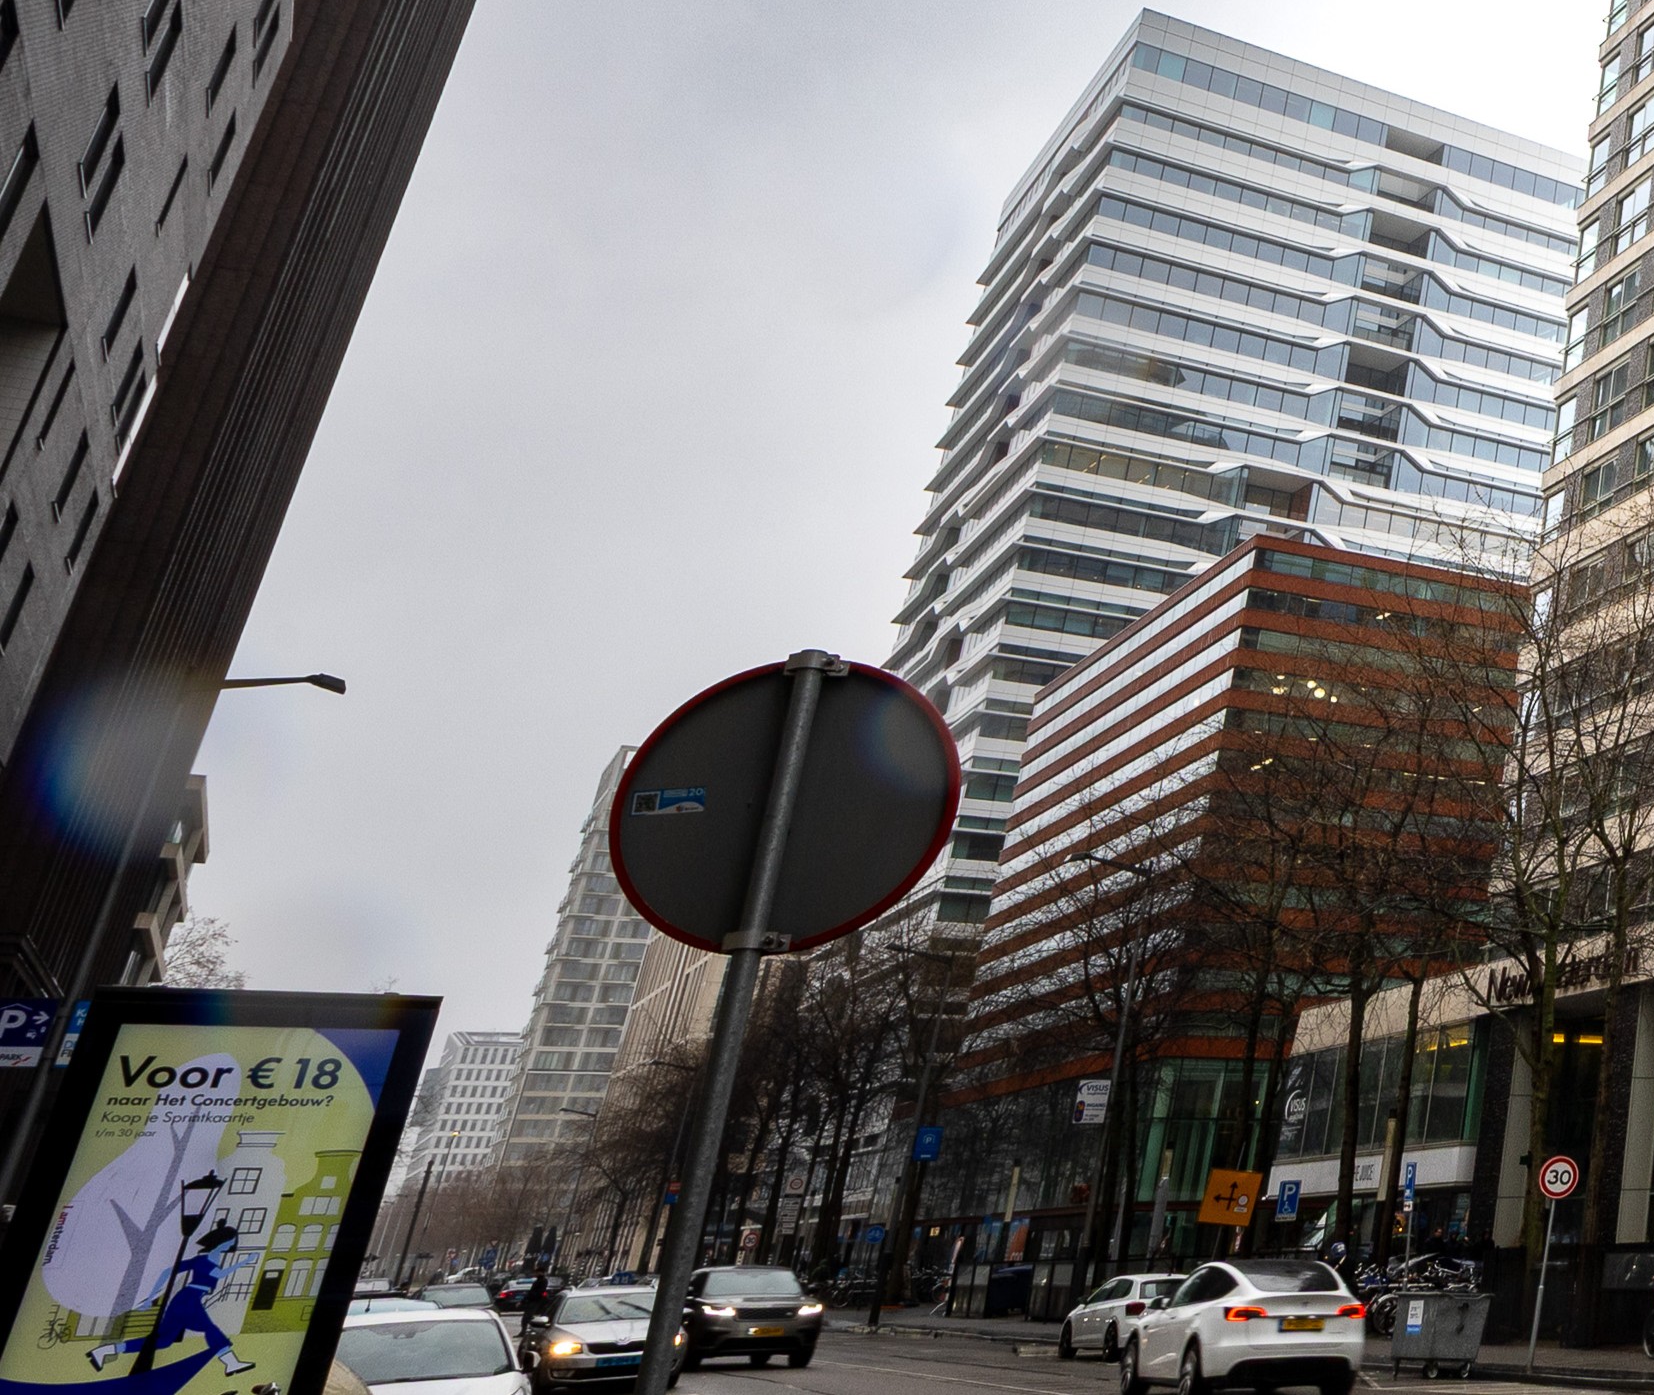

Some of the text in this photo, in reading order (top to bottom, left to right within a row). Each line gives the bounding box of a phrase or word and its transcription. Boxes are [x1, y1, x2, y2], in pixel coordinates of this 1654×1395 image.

[120, 1055, 342, 1089] Voor € 18
[1086, 1084, 1109, 1092] VISUS
[107, 1094, 334, 1110] naar Het Concertgebouw?
[101, 1111, 255, 1126] Koop je Sprintkaartje
[95, 1129, 156, 1139] t/m 30 jaar
[1547, 1169, 1571, 1185] 30
[1283, 1184, 1296, 1201] P
